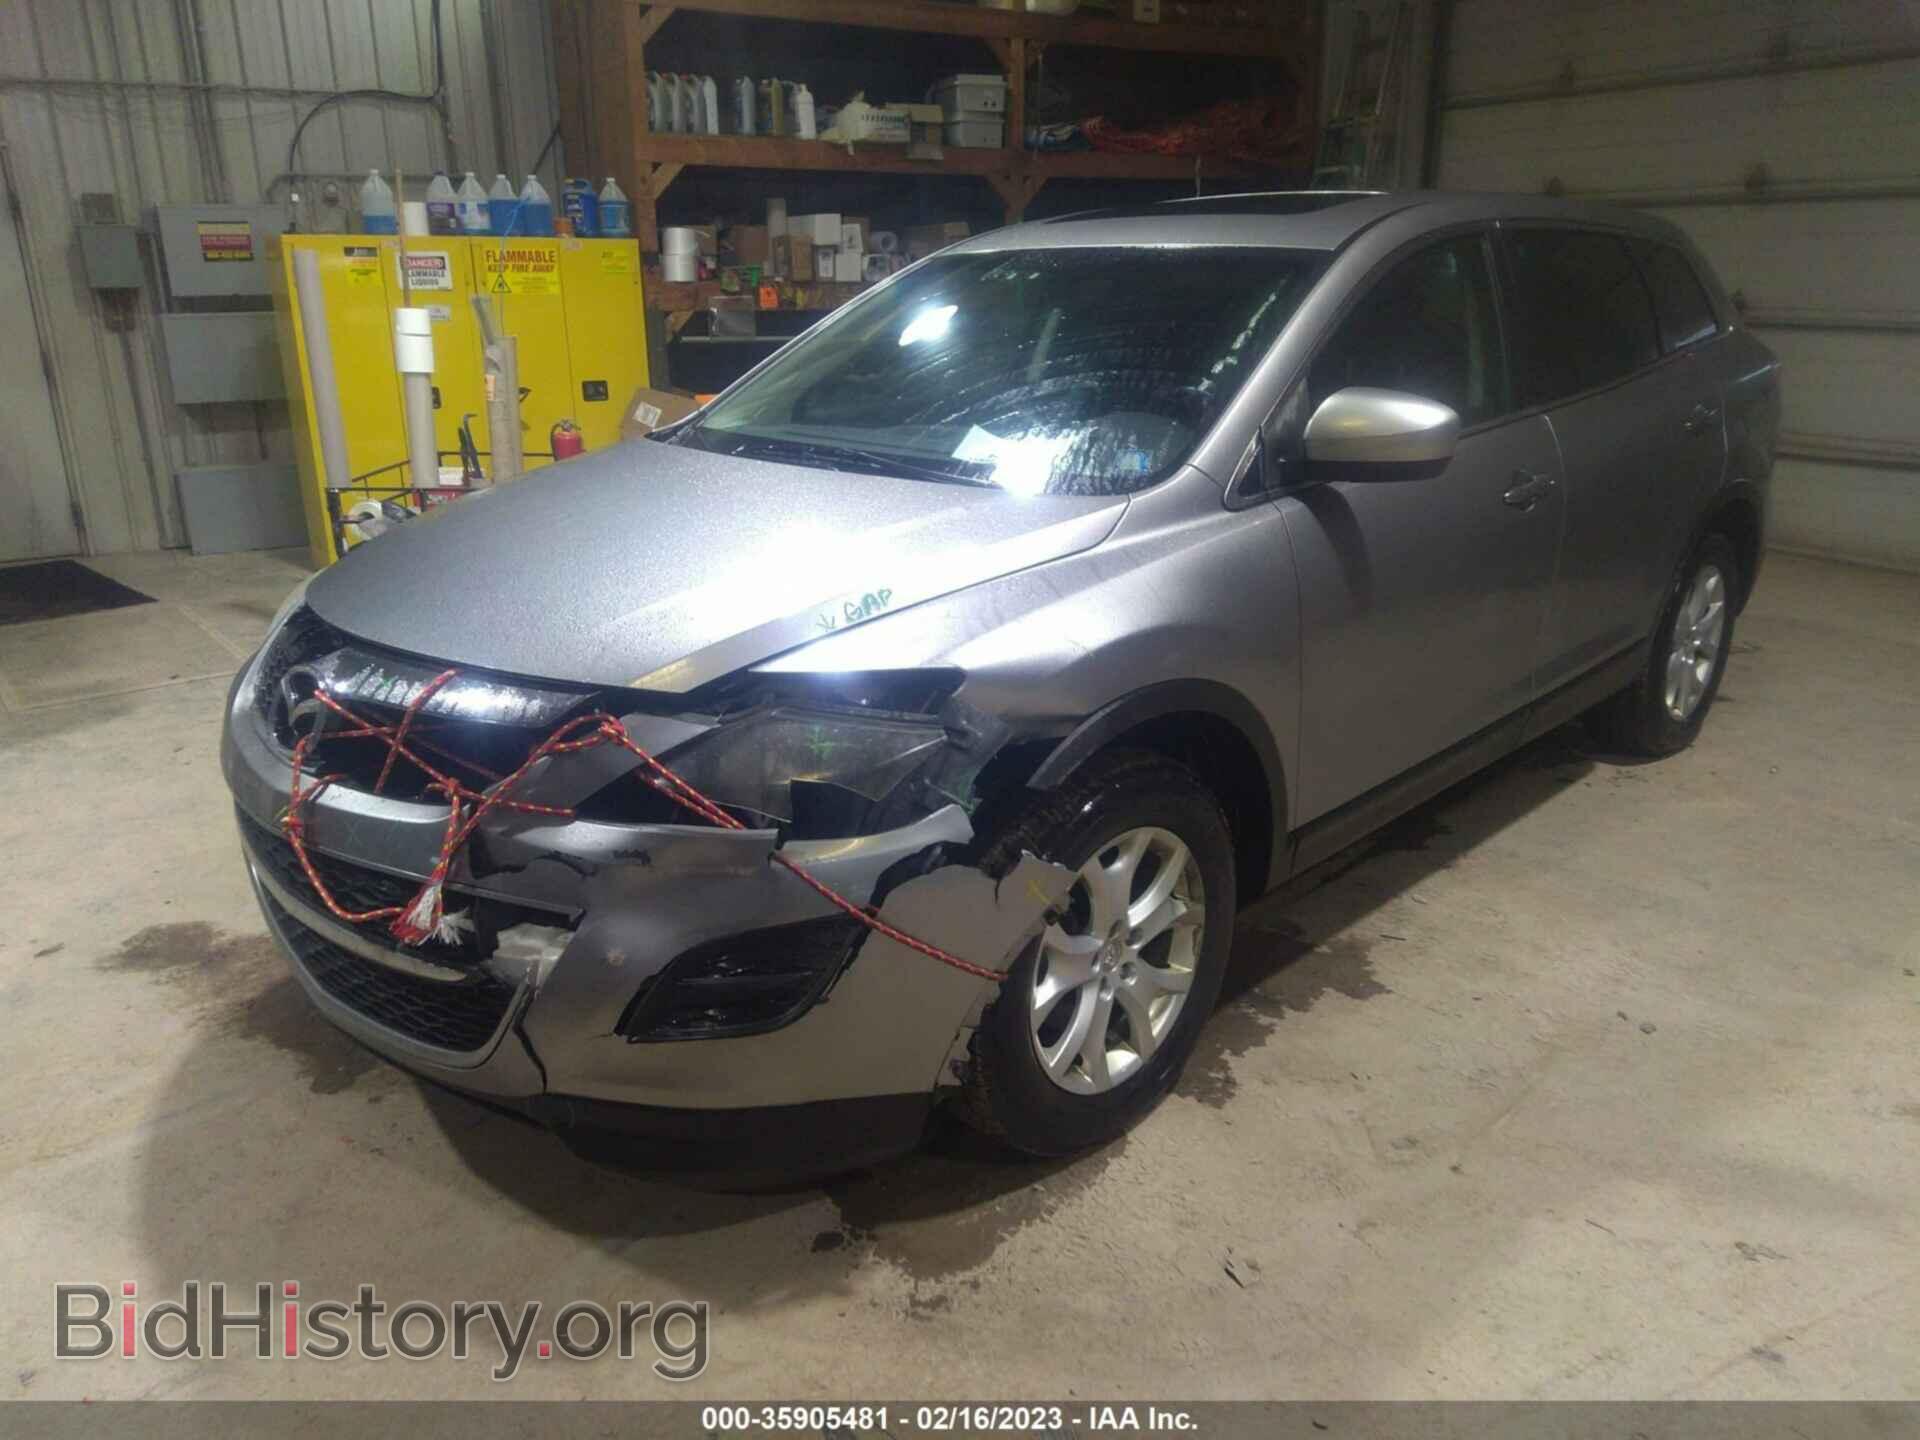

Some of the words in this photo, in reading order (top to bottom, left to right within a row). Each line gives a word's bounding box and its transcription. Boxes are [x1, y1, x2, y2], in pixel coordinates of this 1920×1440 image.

[485, 249, 556, 264] FLAMMABLE
[511, 263, 528, 273] FIRE
[407, 270, 446, 278] LAMMABLE
